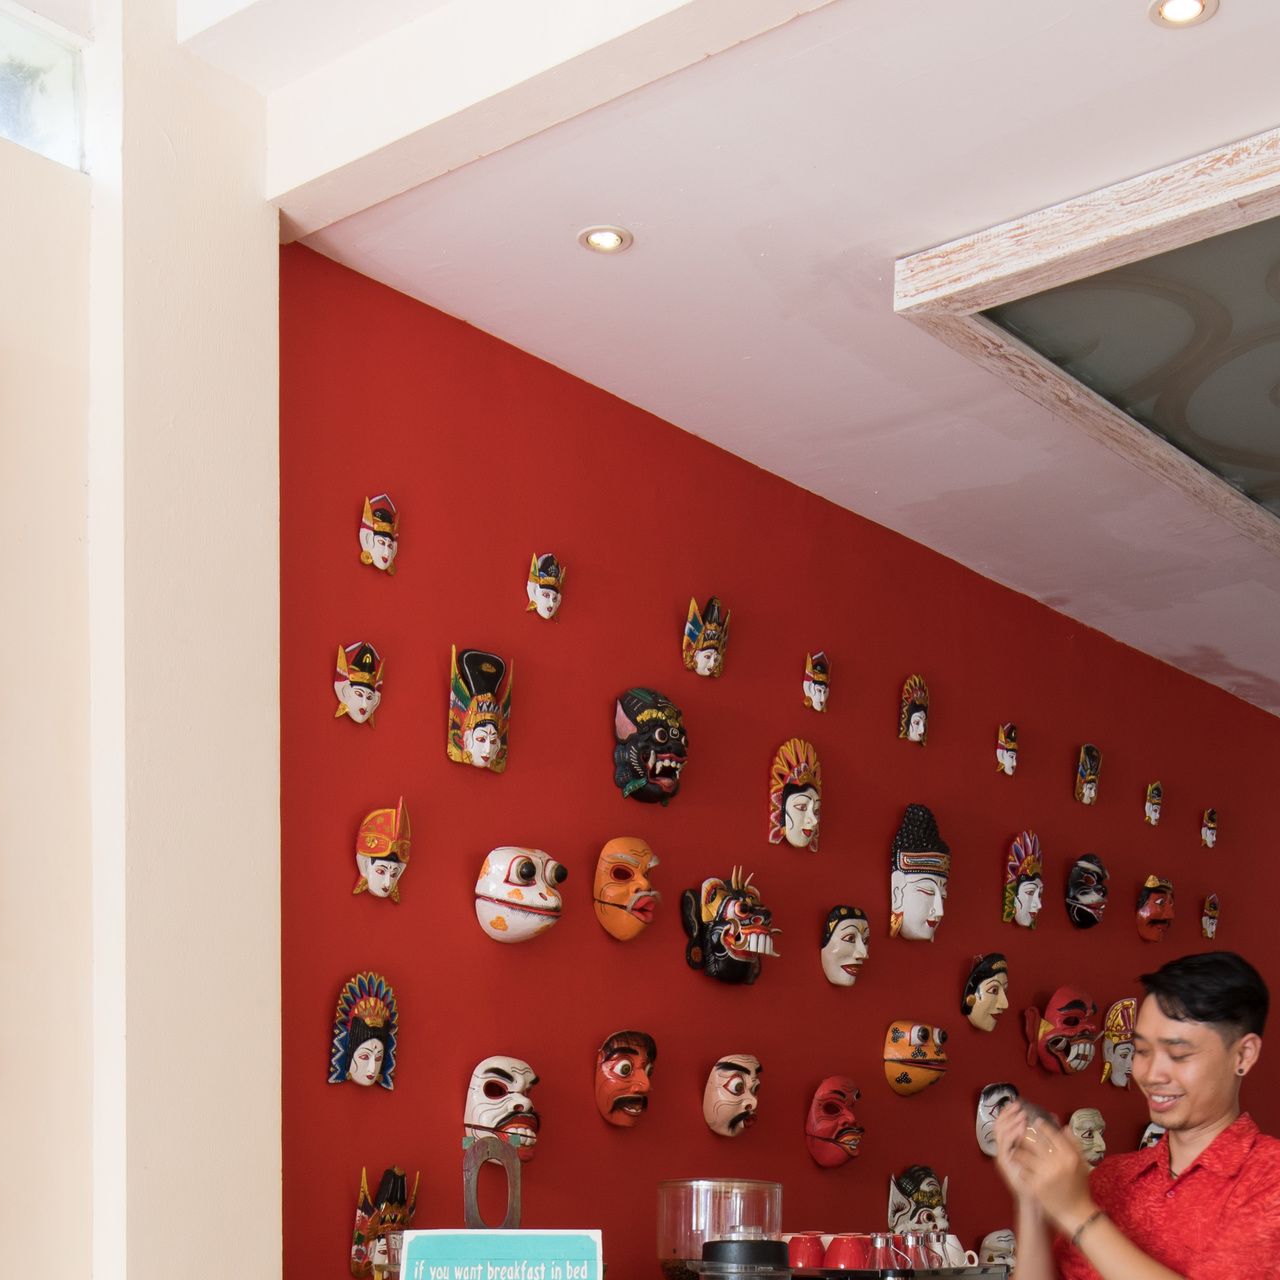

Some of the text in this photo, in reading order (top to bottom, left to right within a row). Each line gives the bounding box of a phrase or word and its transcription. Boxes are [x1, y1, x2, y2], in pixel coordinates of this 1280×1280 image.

[414, 1260, 588, 1280] if you want breakfast in bed
